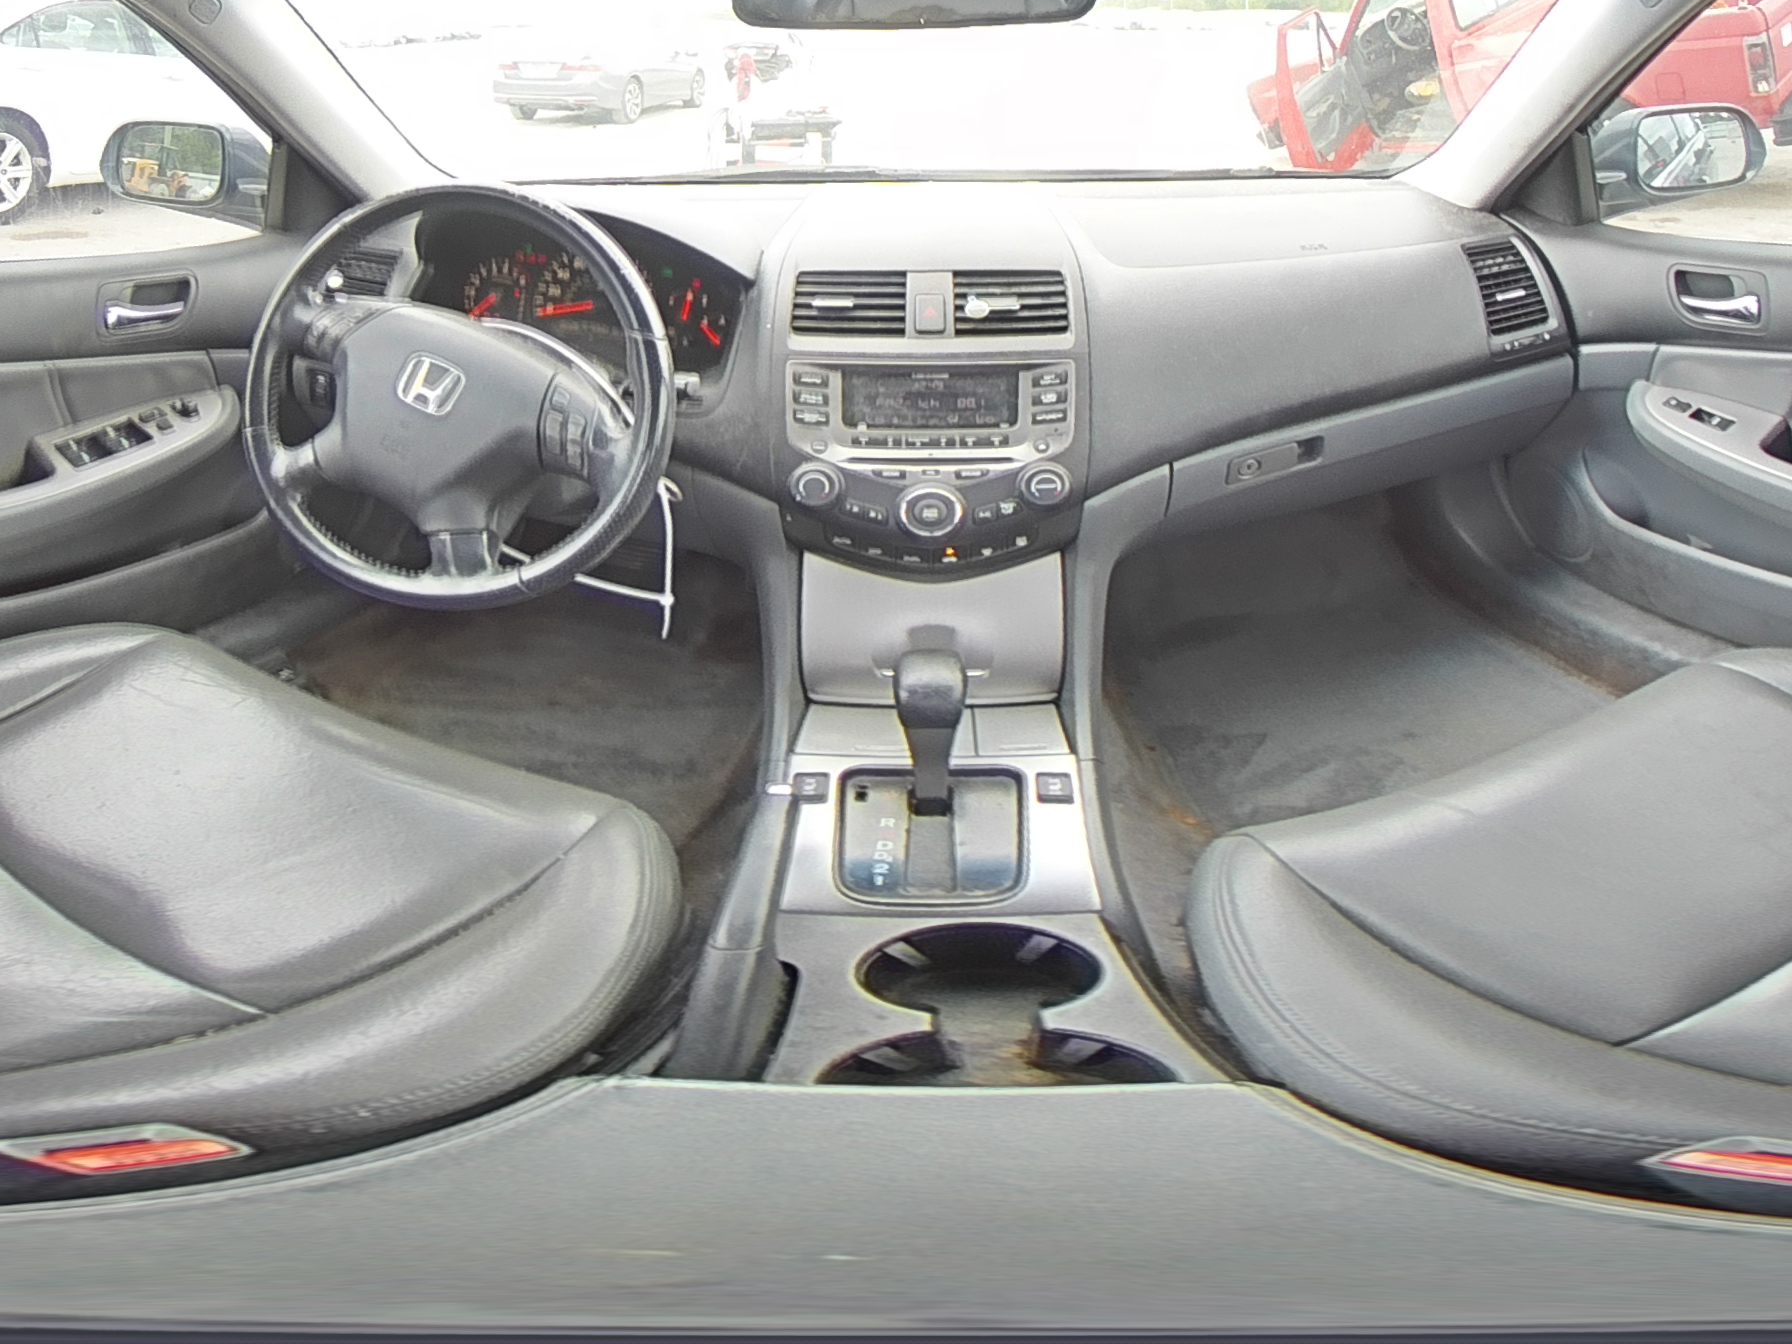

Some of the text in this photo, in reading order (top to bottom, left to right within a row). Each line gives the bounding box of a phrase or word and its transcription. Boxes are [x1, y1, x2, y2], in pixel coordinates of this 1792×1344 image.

[879, 817, 896, 828] R
[876, 840, 894, 850] D
[872, 862, 890, 874] 2
